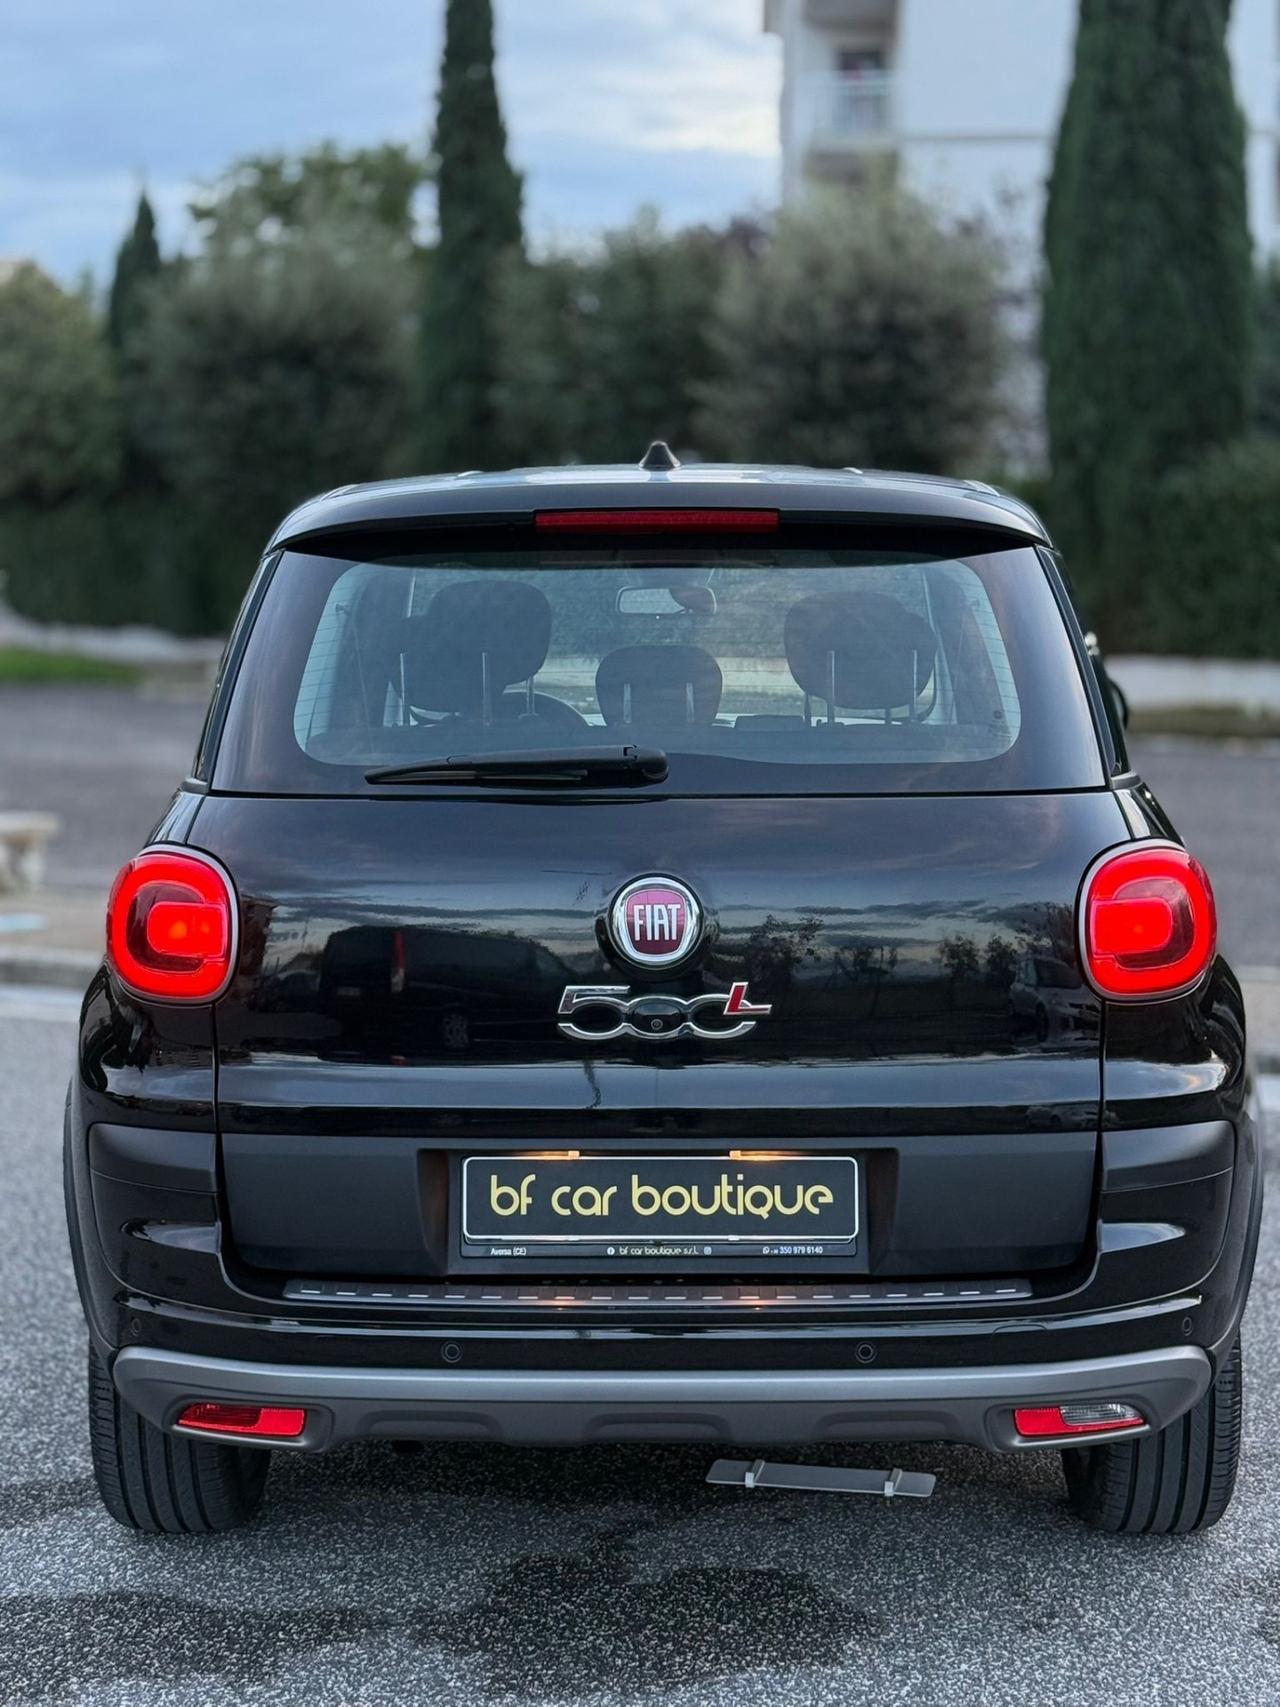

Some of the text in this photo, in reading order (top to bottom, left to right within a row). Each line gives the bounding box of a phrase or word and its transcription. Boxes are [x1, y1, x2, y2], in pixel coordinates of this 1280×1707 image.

[632, 903, 681, 942] FIAT
[490, 1173, 834, 1219] bf car boutique
[619, 1246, 629, 1255] bf
[644, 1246, 682, 1256] boutique
[779, 1246, 792, 1255] 350
